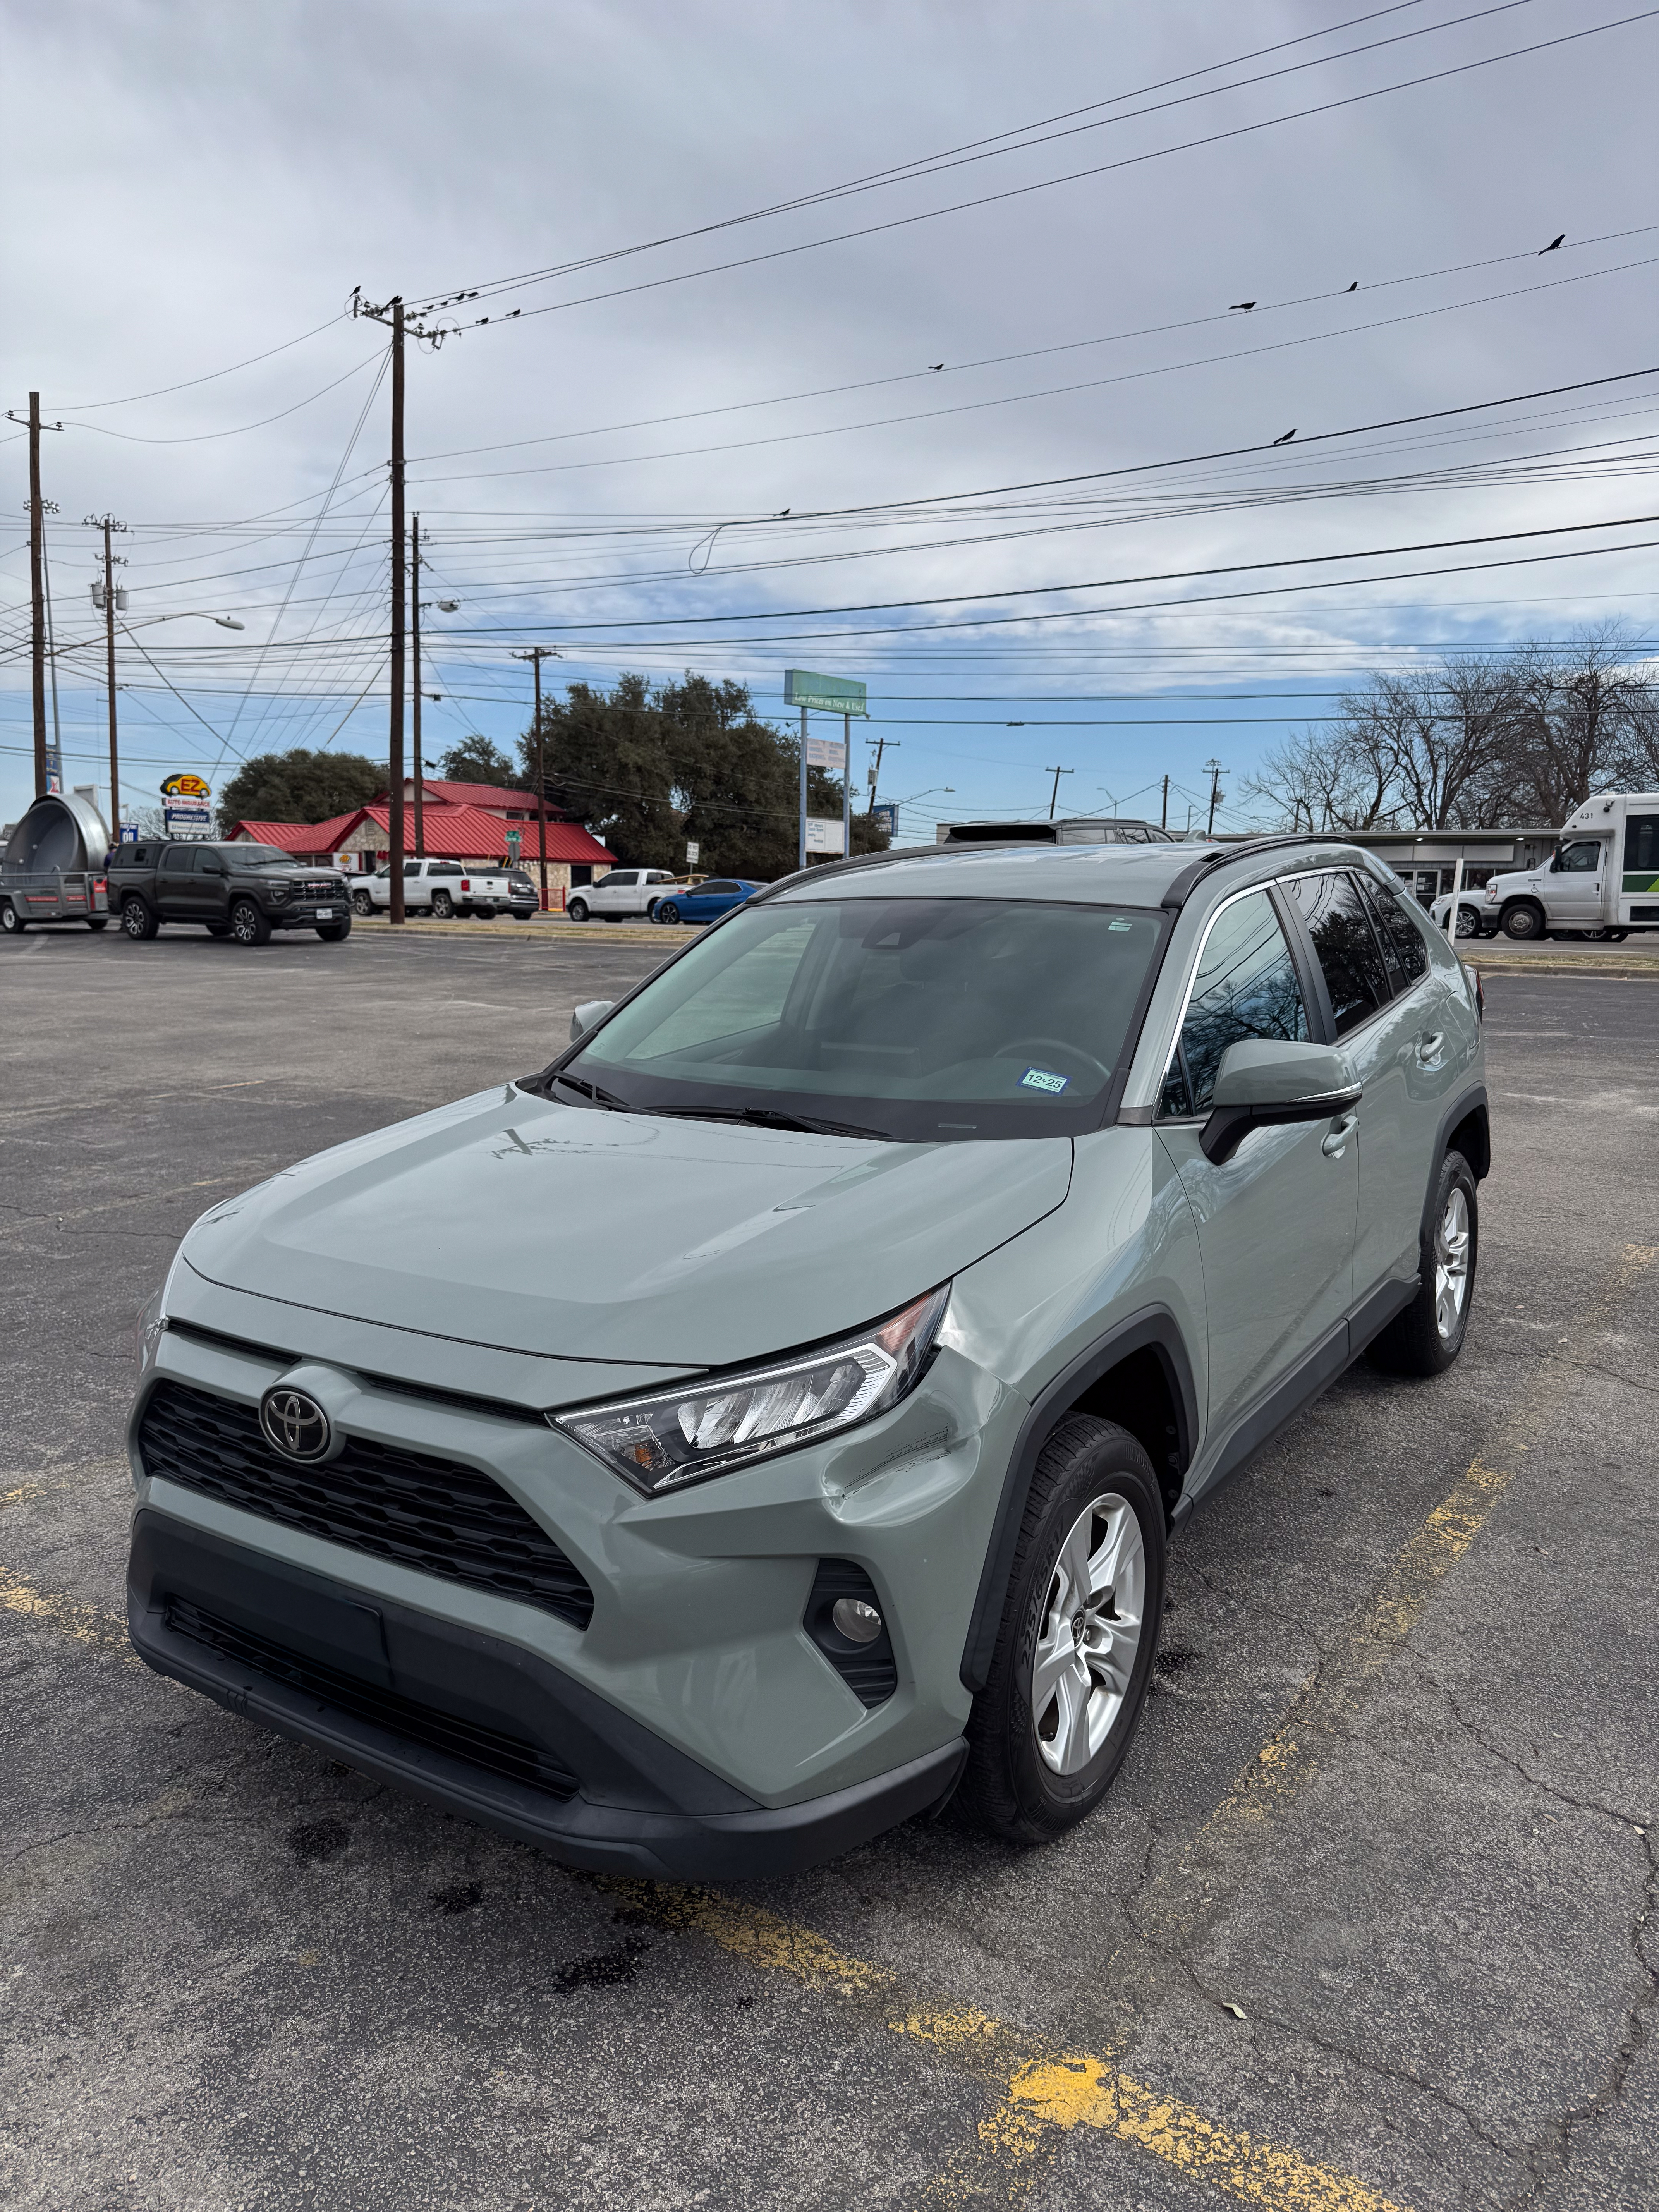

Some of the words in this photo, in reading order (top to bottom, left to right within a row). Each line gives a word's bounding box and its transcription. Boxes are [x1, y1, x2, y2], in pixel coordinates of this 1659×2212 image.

[808, 696, 824, 705] Prices
[833, 700, 845, 709] New
[852, 702, 865, 711] Used
[181, 779, 200, 792] EZ
[1021, 1515, 1063, 1669] 225/65R17
